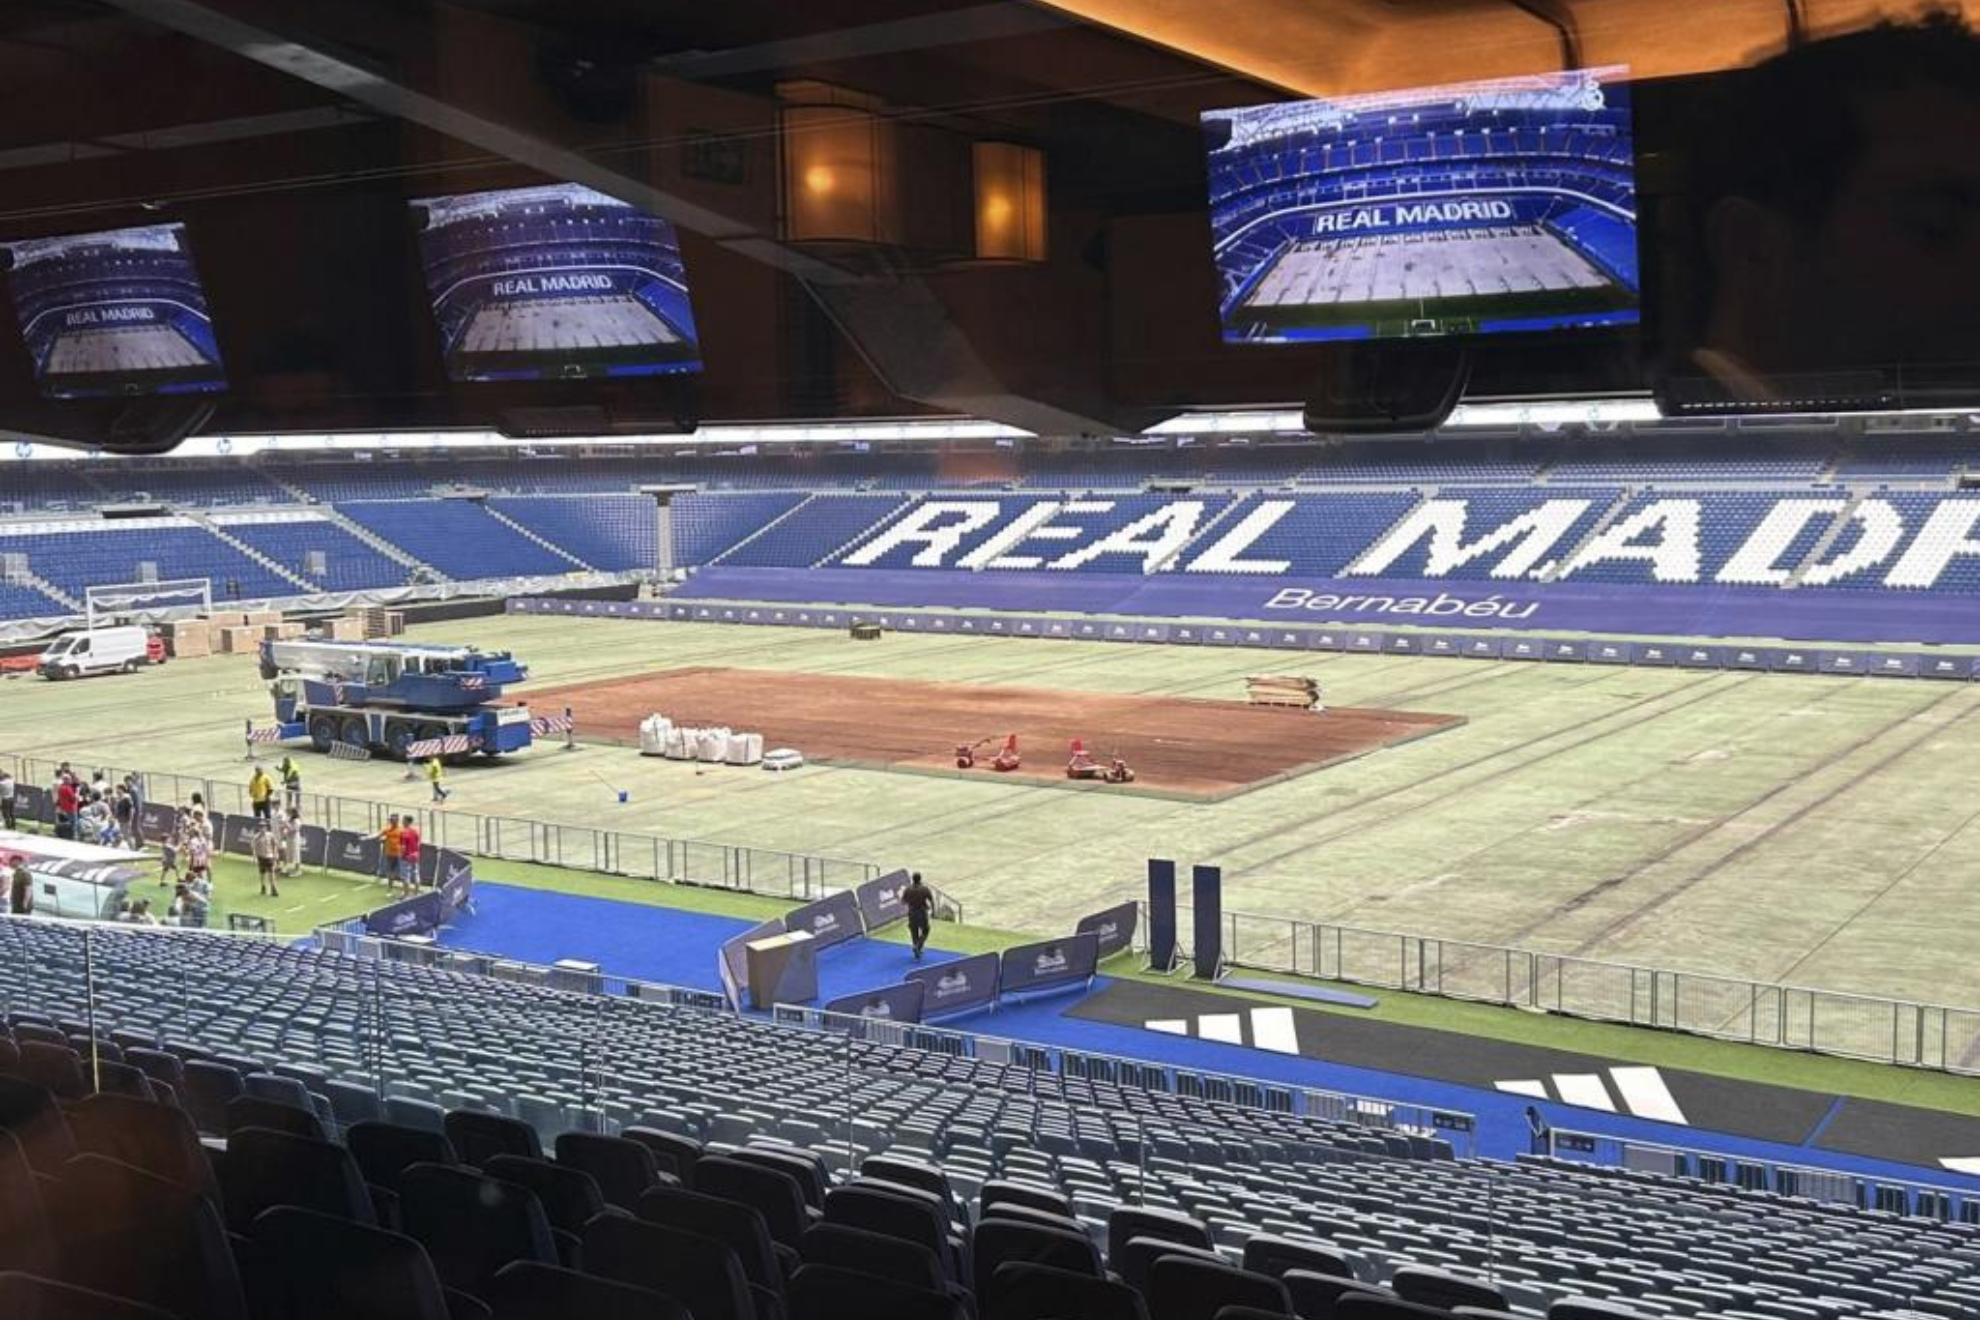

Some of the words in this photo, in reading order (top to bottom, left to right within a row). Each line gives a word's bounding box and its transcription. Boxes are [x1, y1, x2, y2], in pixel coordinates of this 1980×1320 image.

[1317, 209, 1389, 232] REAL
[1396, 201, 1511, 225] MADRID
[494, 279, 539, 296] REAL
[541, 275, 612, 291] MADRID
[842, 500, 1296, 574] REAL
[1264, 588, 1540, 619] Bernabéu
